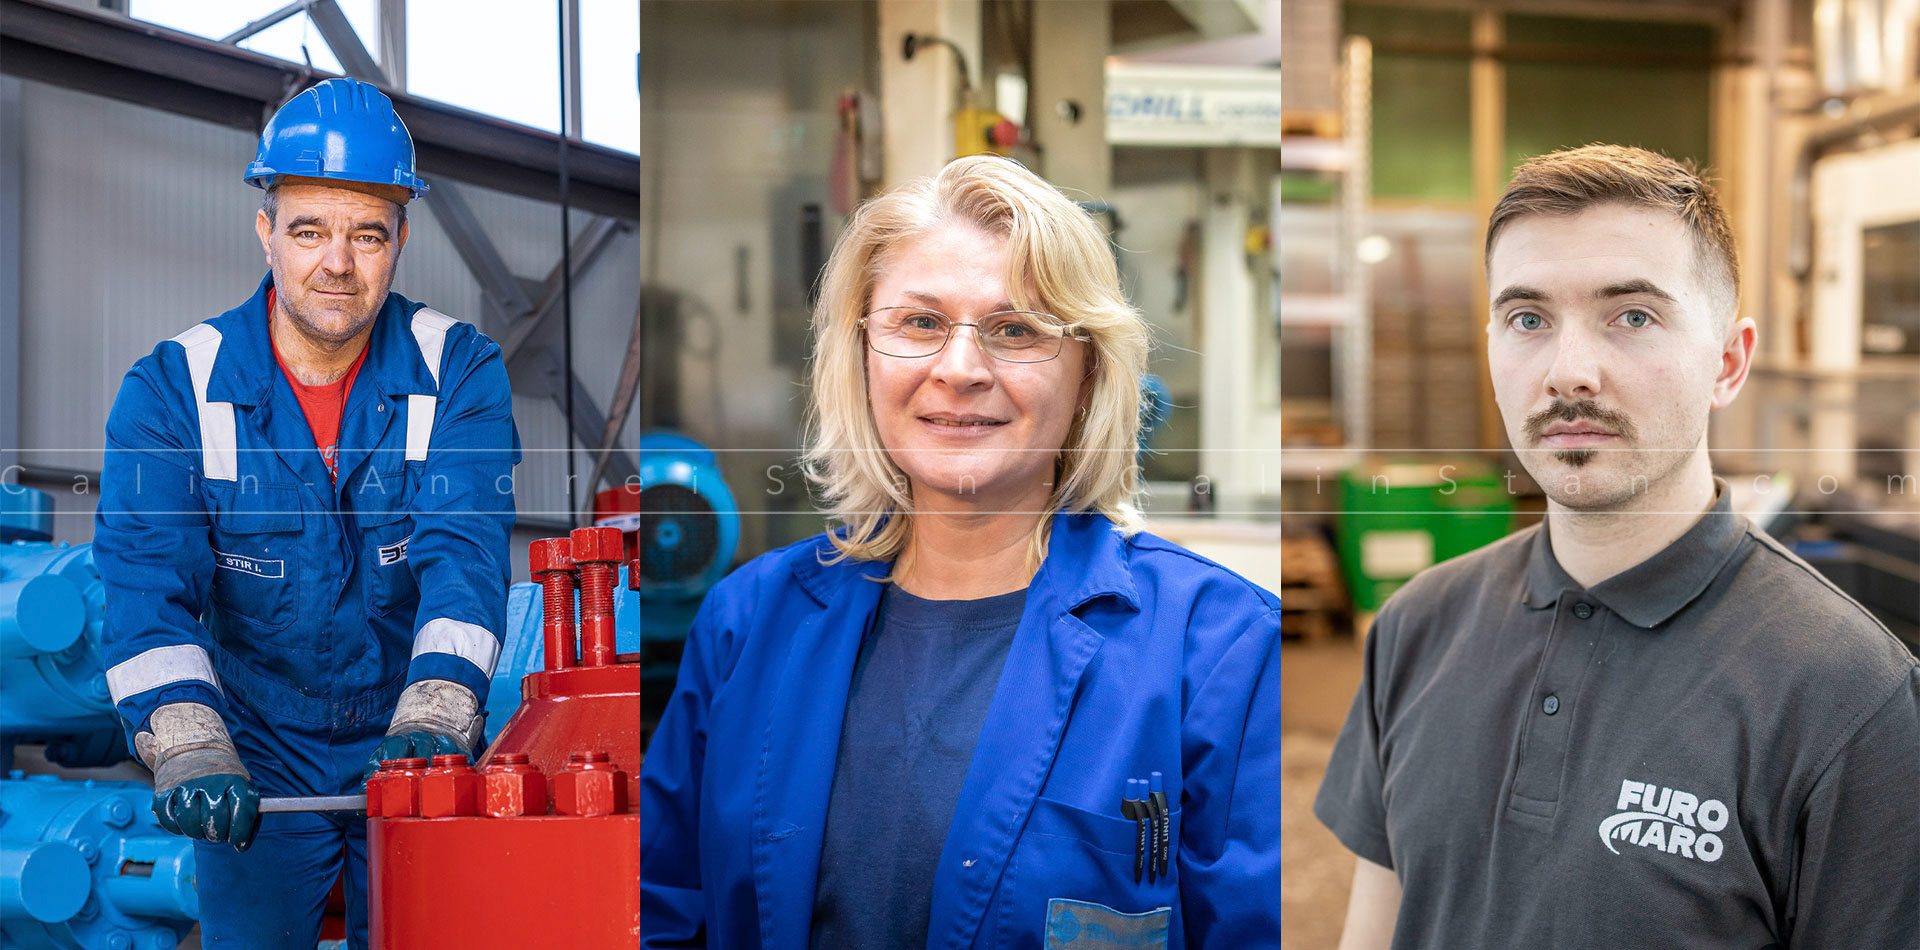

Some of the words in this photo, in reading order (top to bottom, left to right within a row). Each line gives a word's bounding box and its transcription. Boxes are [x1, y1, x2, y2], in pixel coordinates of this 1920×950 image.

[226, 557, 252, 570] STIR
[1616, 779, 1729, 832] FURO
[1610, 820, 1724, 862] MARO
